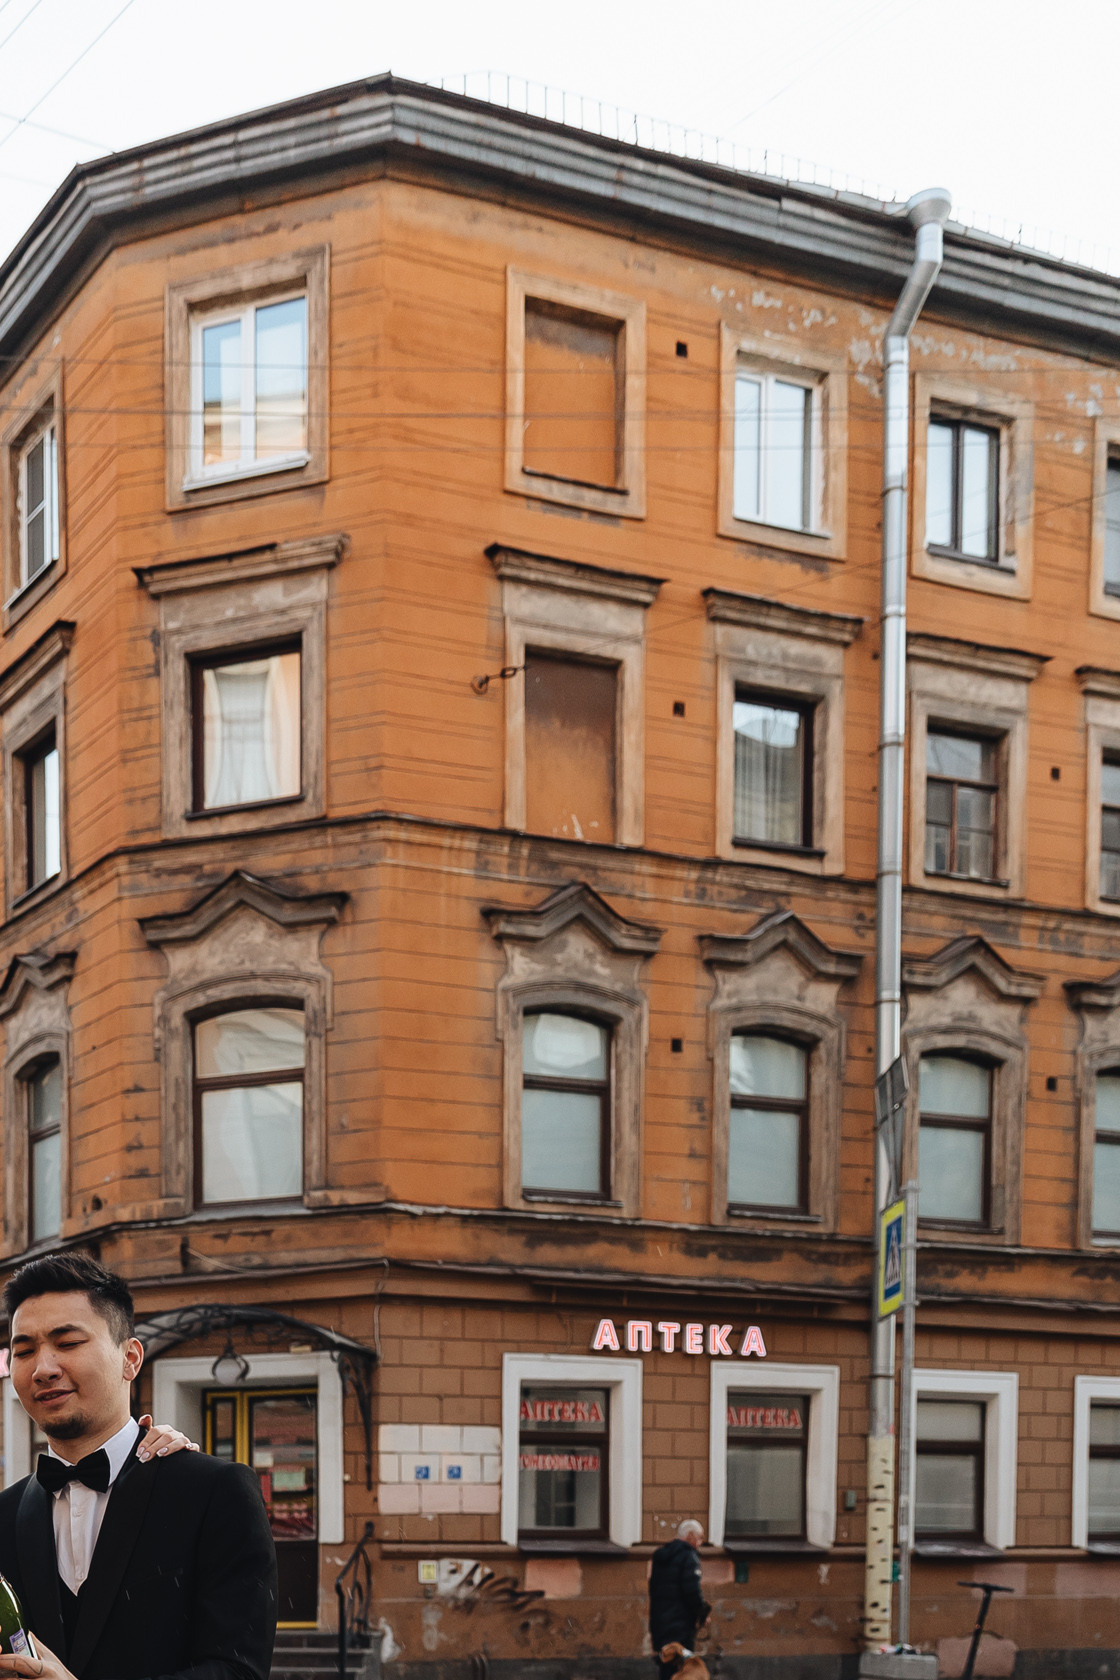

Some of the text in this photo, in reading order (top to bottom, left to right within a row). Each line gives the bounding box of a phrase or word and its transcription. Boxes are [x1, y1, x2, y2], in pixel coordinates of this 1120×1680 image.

[593, 1319, 767, 1356] АПТЕКА
[519, 1399, 605, 1422] АПТЕКА
[726, 1406, 803, 1429] АПТЕКА
